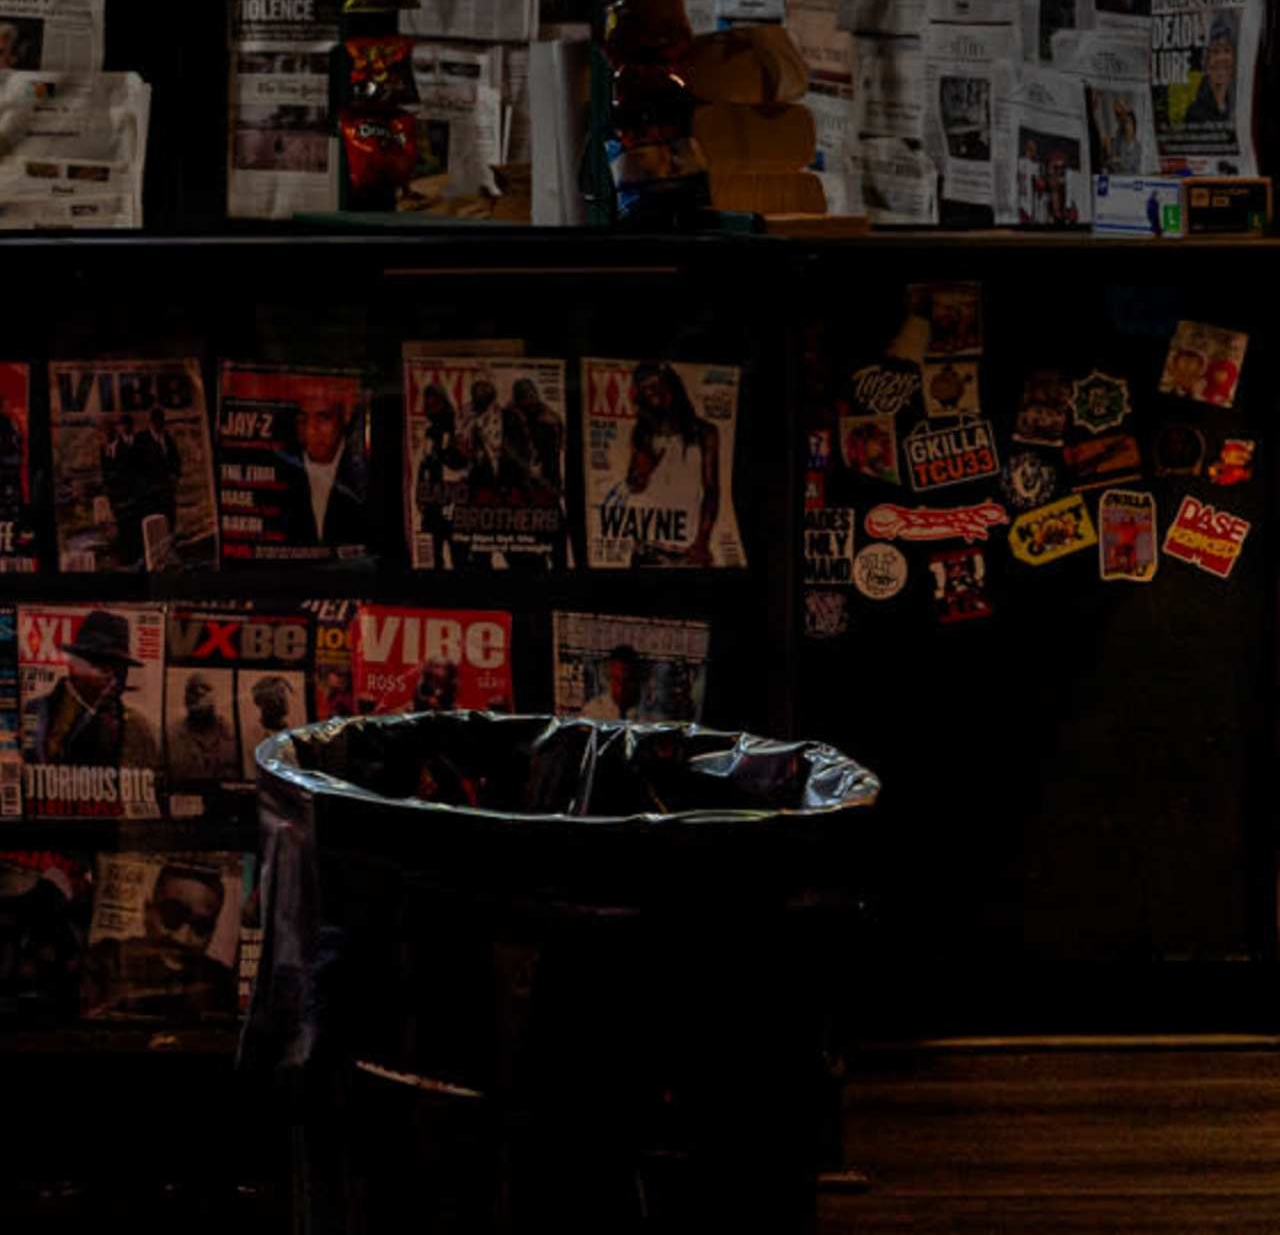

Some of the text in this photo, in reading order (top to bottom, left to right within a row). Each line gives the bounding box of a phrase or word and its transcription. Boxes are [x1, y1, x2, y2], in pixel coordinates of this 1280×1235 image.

[590, 370, 640, 415] XX
[600, 505, 687, 542] WAYNE
[367, 673, 407, 692] ROSS
